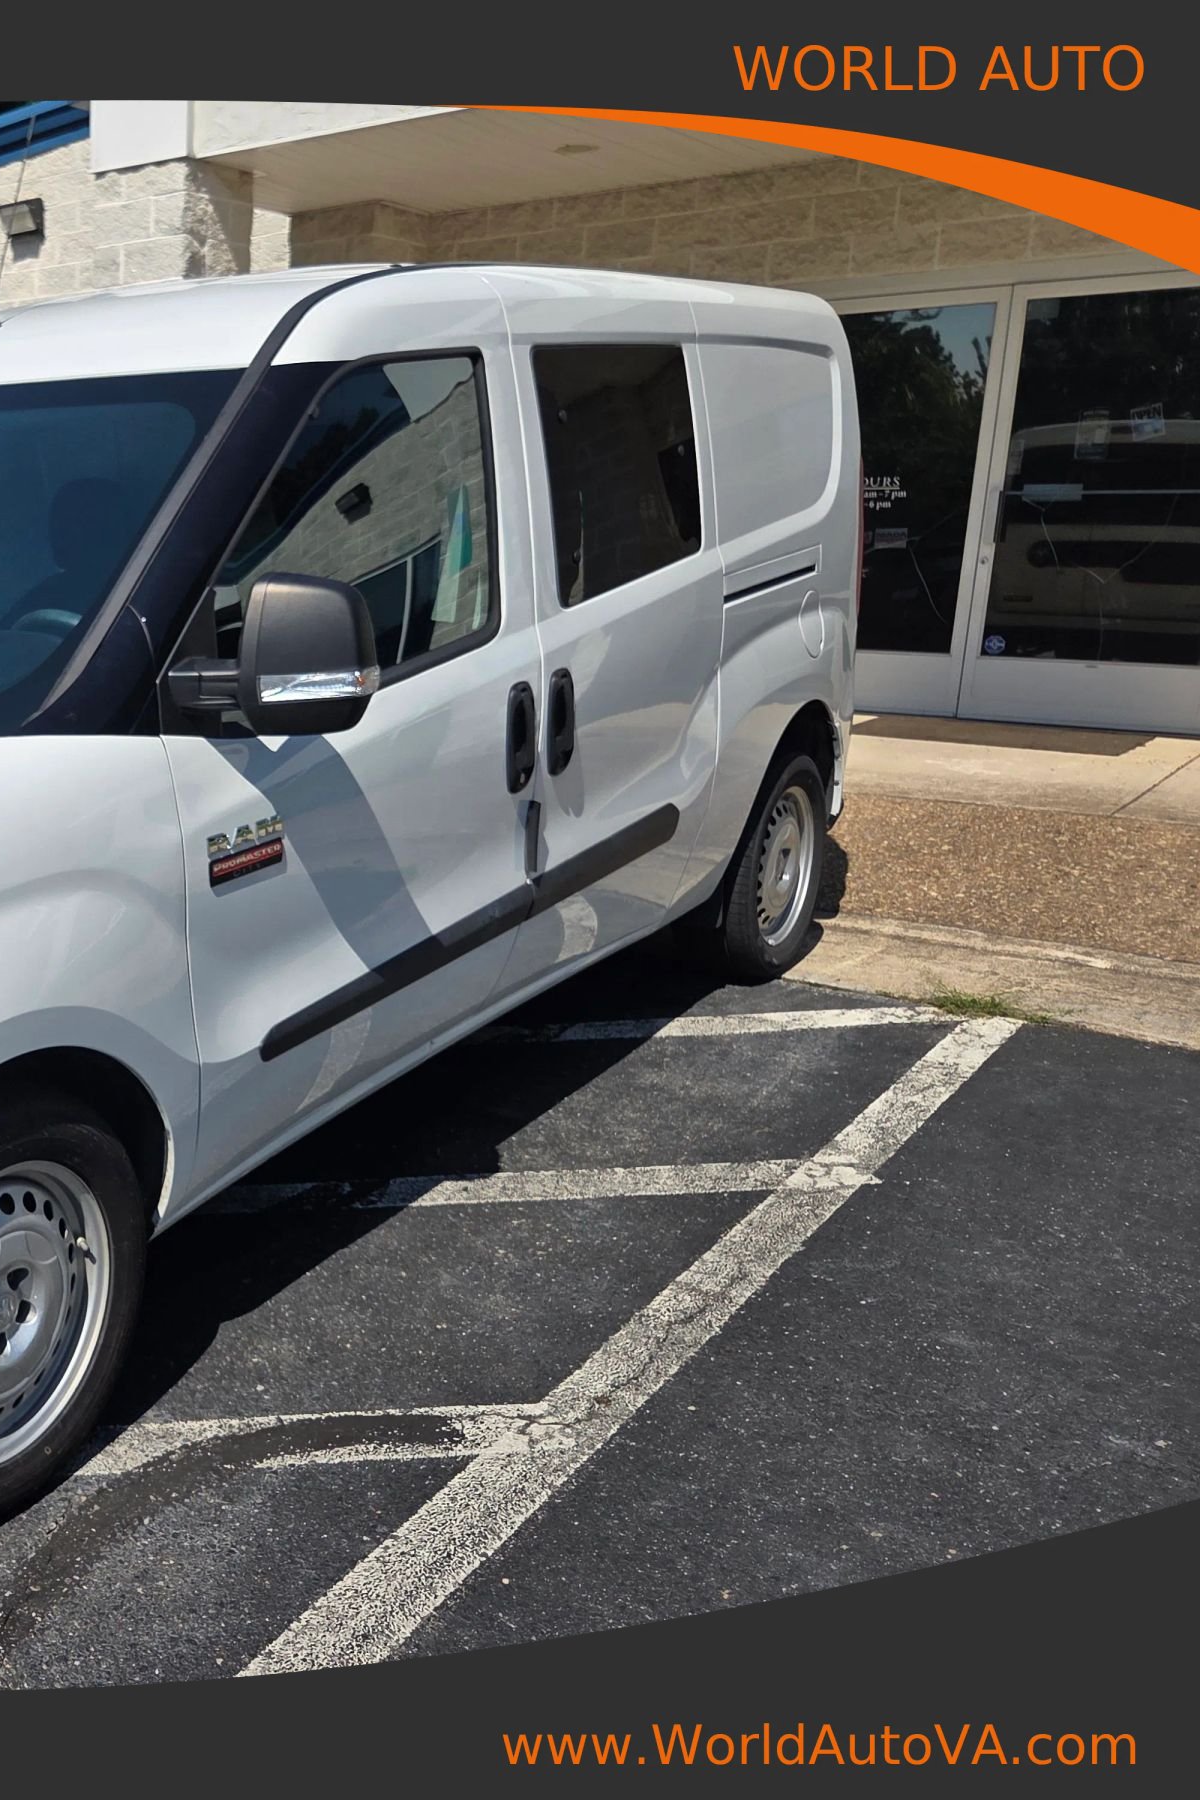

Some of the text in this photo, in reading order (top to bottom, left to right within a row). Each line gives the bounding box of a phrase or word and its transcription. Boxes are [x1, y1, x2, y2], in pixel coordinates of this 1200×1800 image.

[1132, 405, 1161, 420] OPEN
[863, 476, 900, 488] OURS
[891, 491, 907, 501] pm
[876, 501, 891, 511] pm
[207, 815, 284, 861] RAM
[212, 843, 282, 872] PROMASTER
